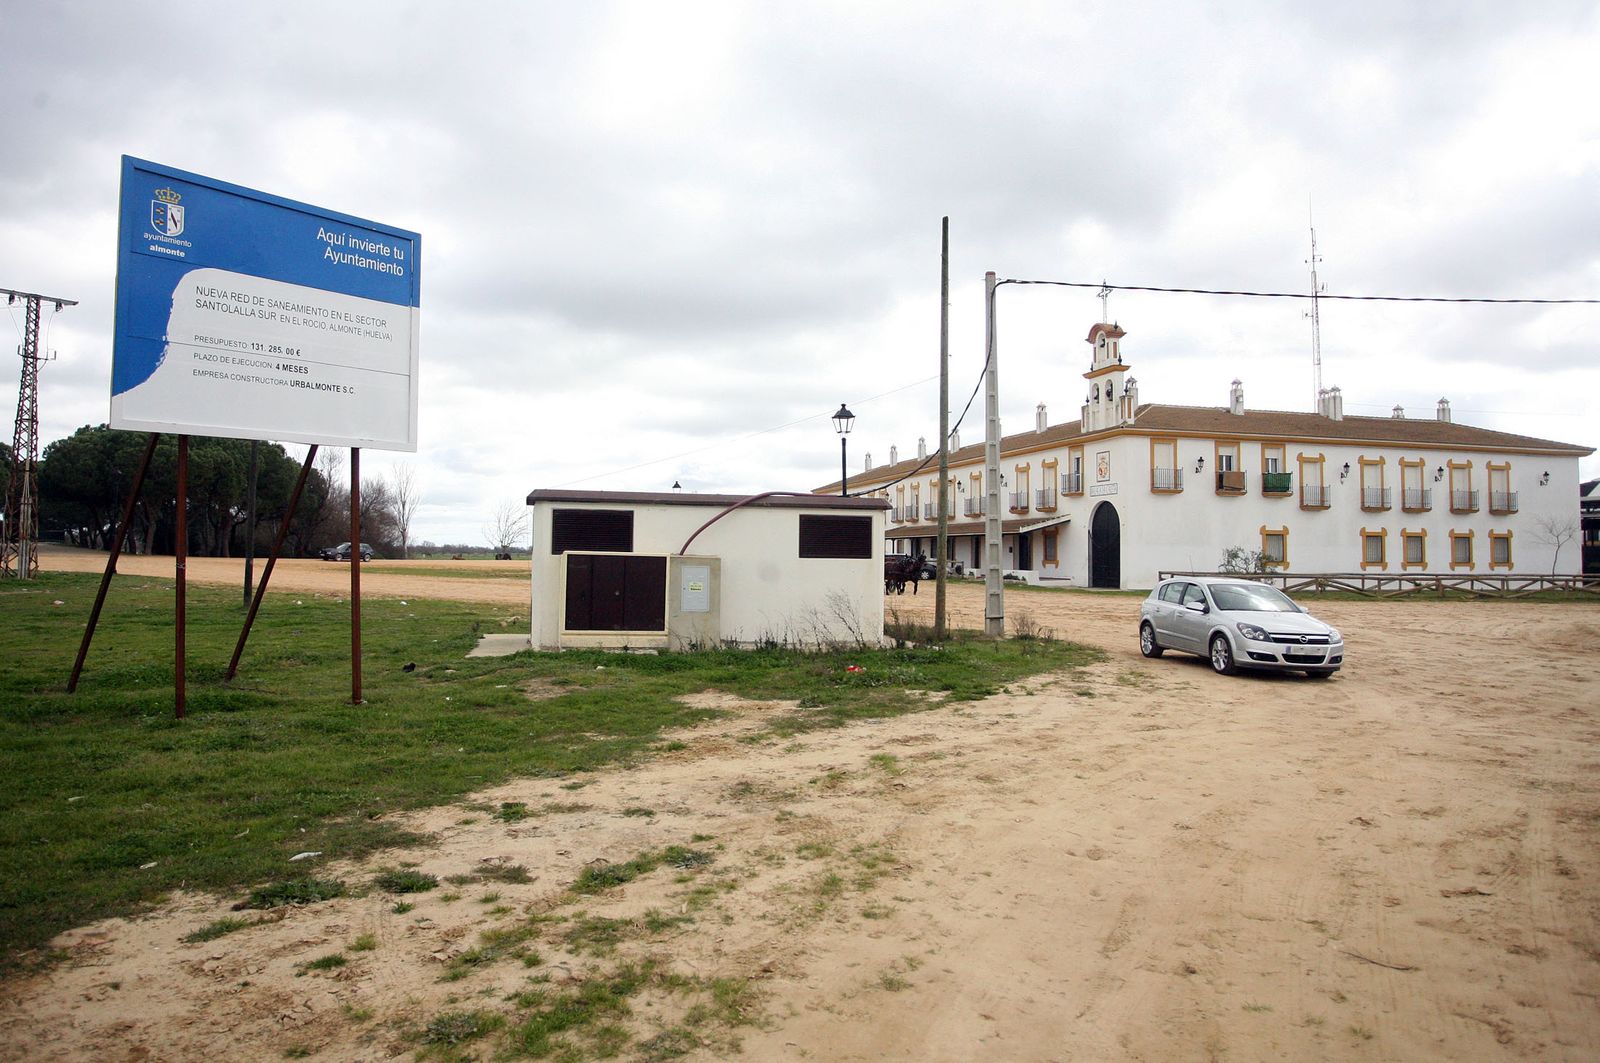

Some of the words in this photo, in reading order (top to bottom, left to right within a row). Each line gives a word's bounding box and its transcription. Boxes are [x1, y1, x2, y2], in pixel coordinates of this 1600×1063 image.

[143, 232, 192, 248] ayuntamiento
[149, 244, 186, 258] almonte
[317, 227, 346, 246] Aquí
[349, 234, 390, 257] invierte
[393, 246, 404, 260] tu
[324, 246, 404, 276] Ayuntamiento
[195, 286, 229, 299] NUEVA
[230, 292, 250, 304] RED
[252, 295, 265, 307] DE
[267, 298, 329, 318] SANEAMIENTO
[330, 310, 342, 320] EN
[344, 312, 353, 323] EL
[355, 314, 387, 328] SECTOR
[195, 298, 256, 318] SANTOLALLA
[257, 309, 277, 321] SUR
[280, 314, 291, 324] EN
[292, 316, 301, 326] EL
[329, 323, 362, 336] ALMONTE
[363, 329, 393, 342] (HUELVA)
[193, 352, 219, 363] PLAZO
[219, 356, 231, 364] DE
[275, 363, 281, 371] 4
[282, 363, 309, 375] MESES
[285, 347, 295, 356] 00
[296, 349, 301, 357] €
[192, 368, 230, 380] EMPRESA
[230, 373, 288, 386] CONSTRUCTORA
[289, 380, 341, 392] URBALMONTE
